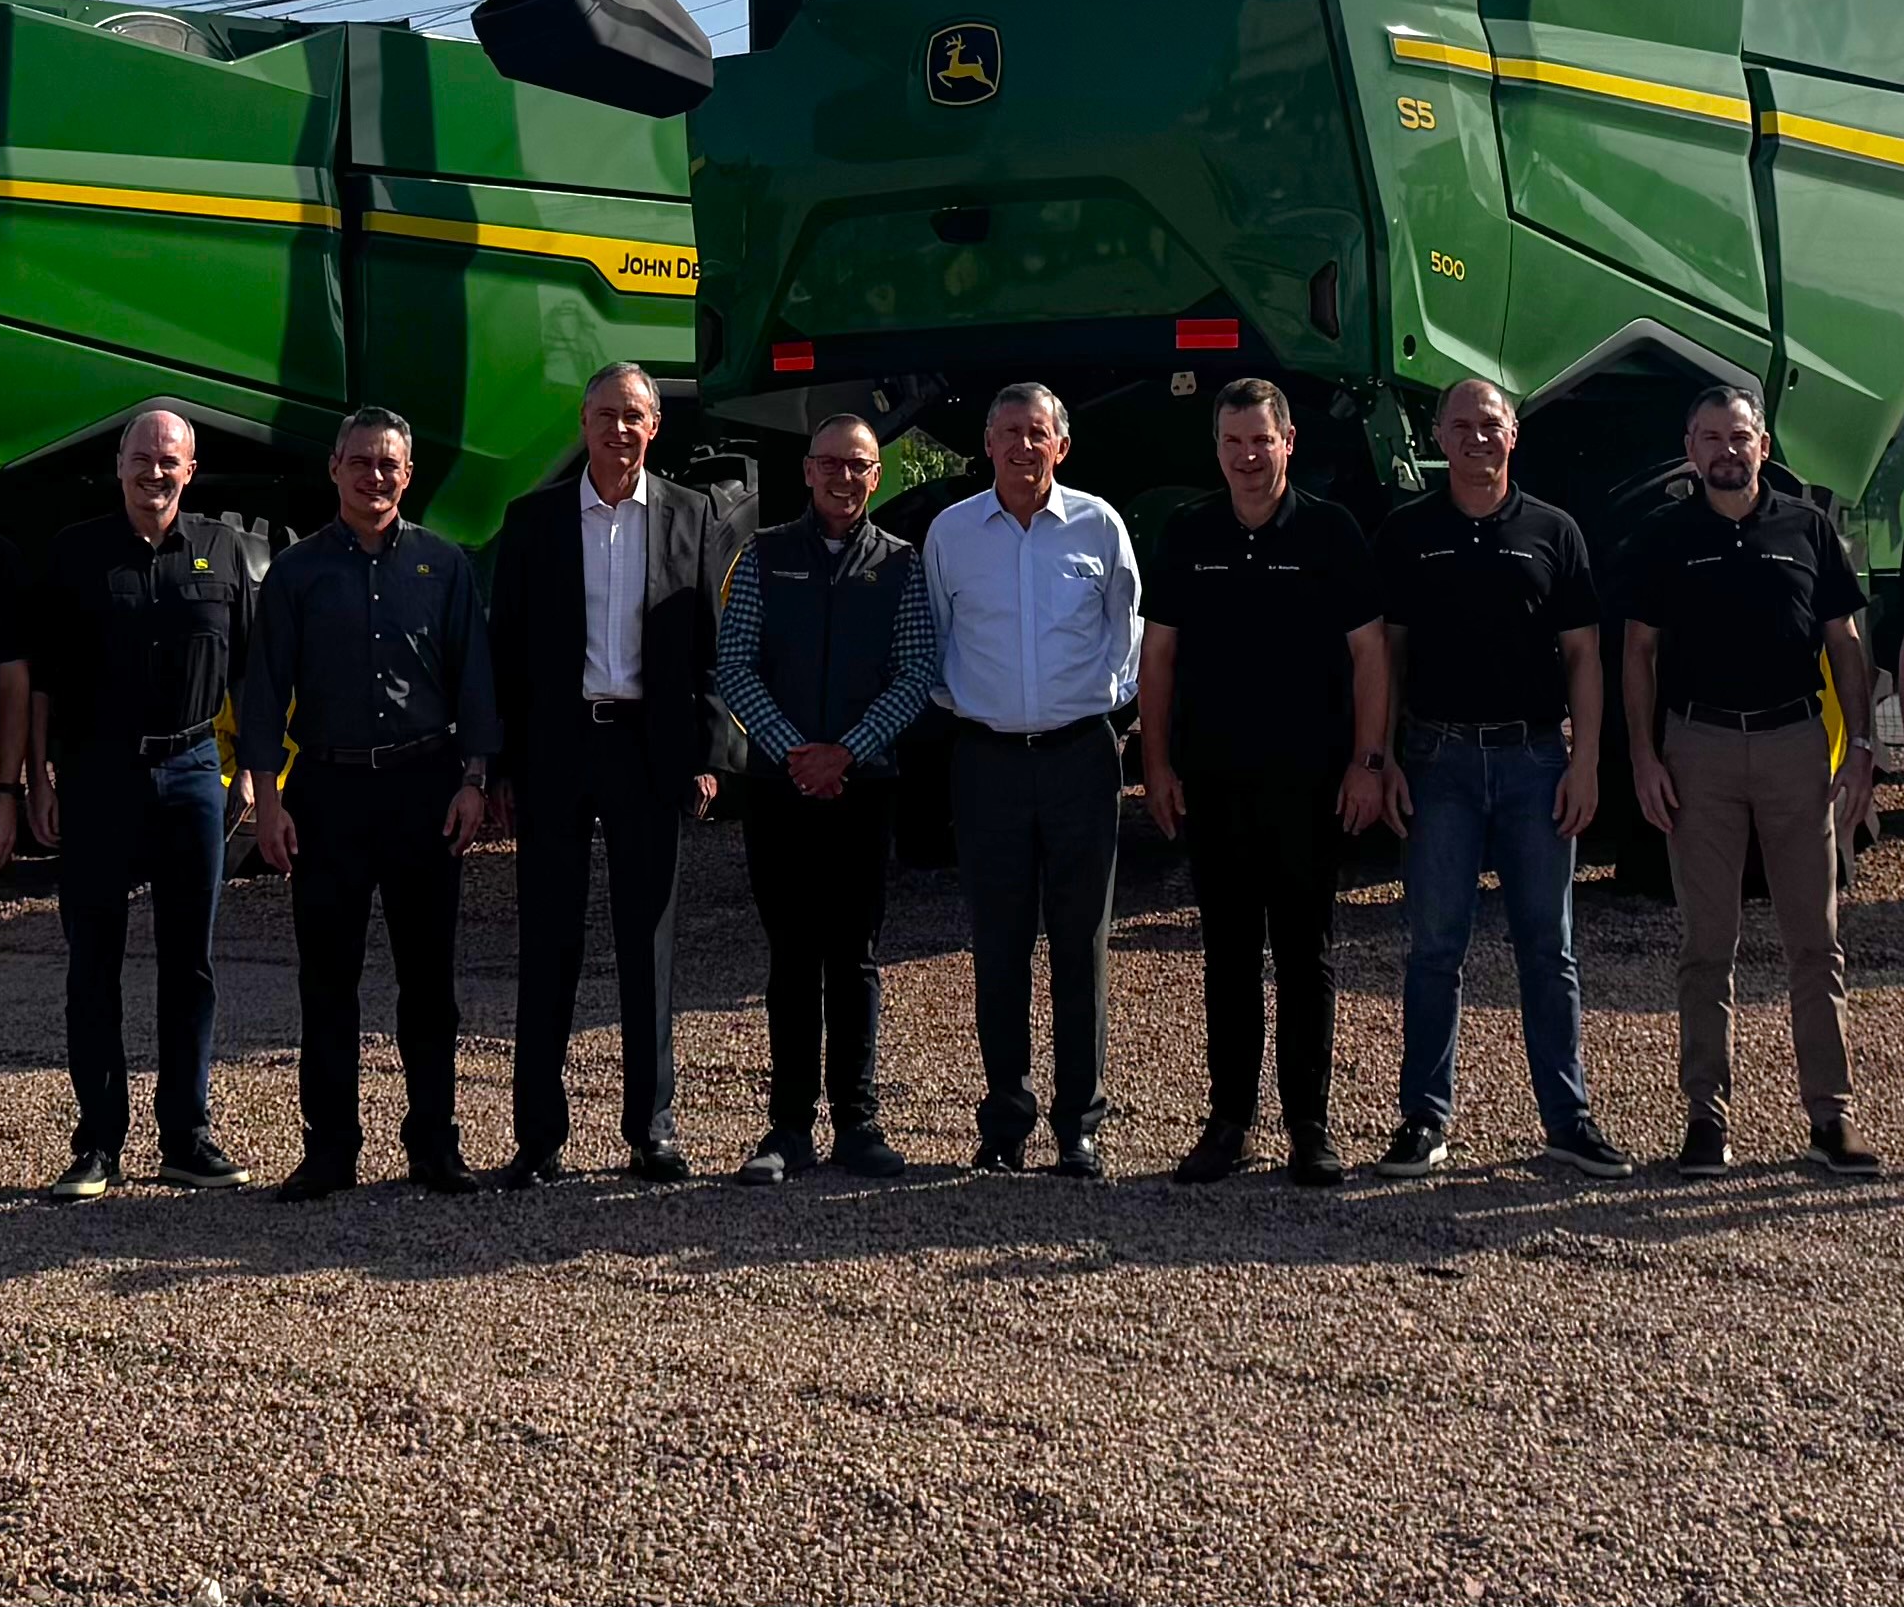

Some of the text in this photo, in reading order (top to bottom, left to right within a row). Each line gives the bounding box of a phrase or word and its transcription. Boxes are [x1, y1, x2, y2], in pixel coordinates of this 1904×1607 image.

[1396, 96, 1436, 130] S5
[618, 252, 672, 278] JOHN
[1431, 250, 1465, 281] 500
